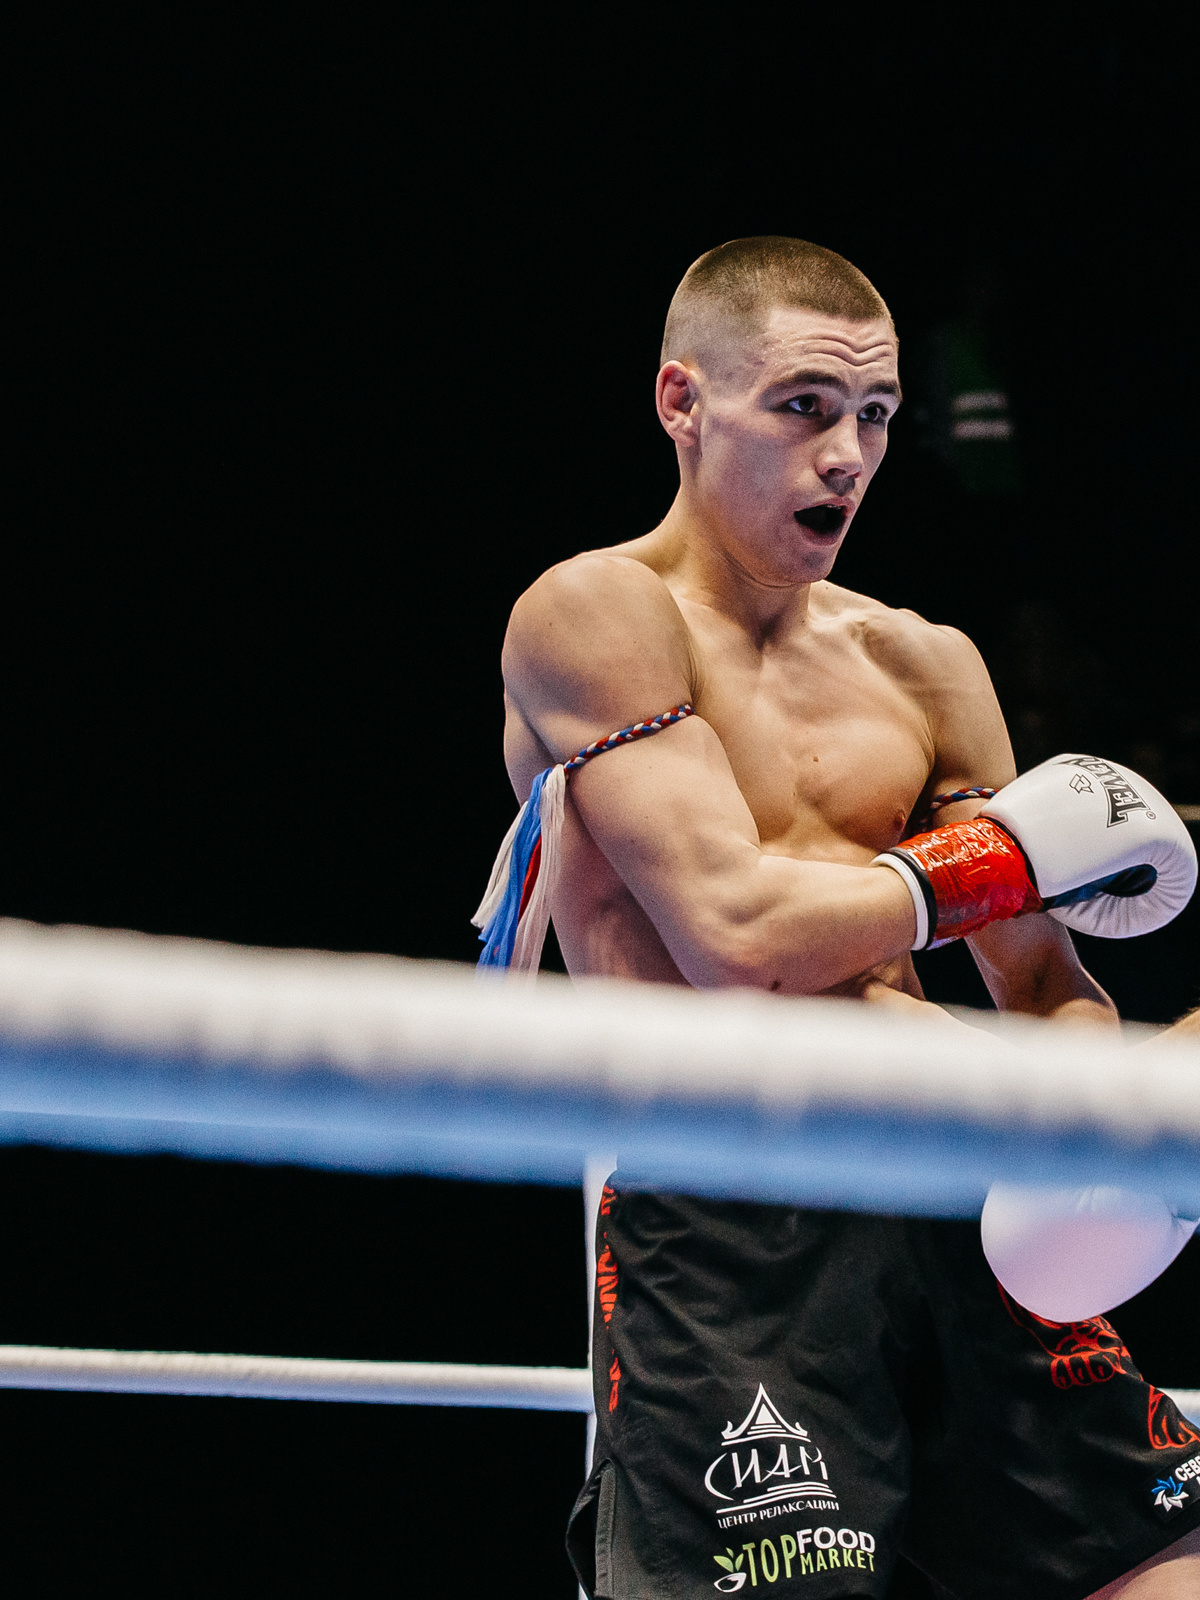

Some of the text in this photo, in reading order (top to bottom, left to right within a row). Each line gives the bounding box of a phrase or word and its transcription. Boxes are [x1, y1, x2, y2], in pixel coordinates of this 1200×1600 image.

[717, 1499, 840, 1530] ЦЕНТР РЕЛАКСАЦИИ
[742, 1526, 876, 1587] TOP FOOD
[800, 1547, 876, 1576] MARKET
